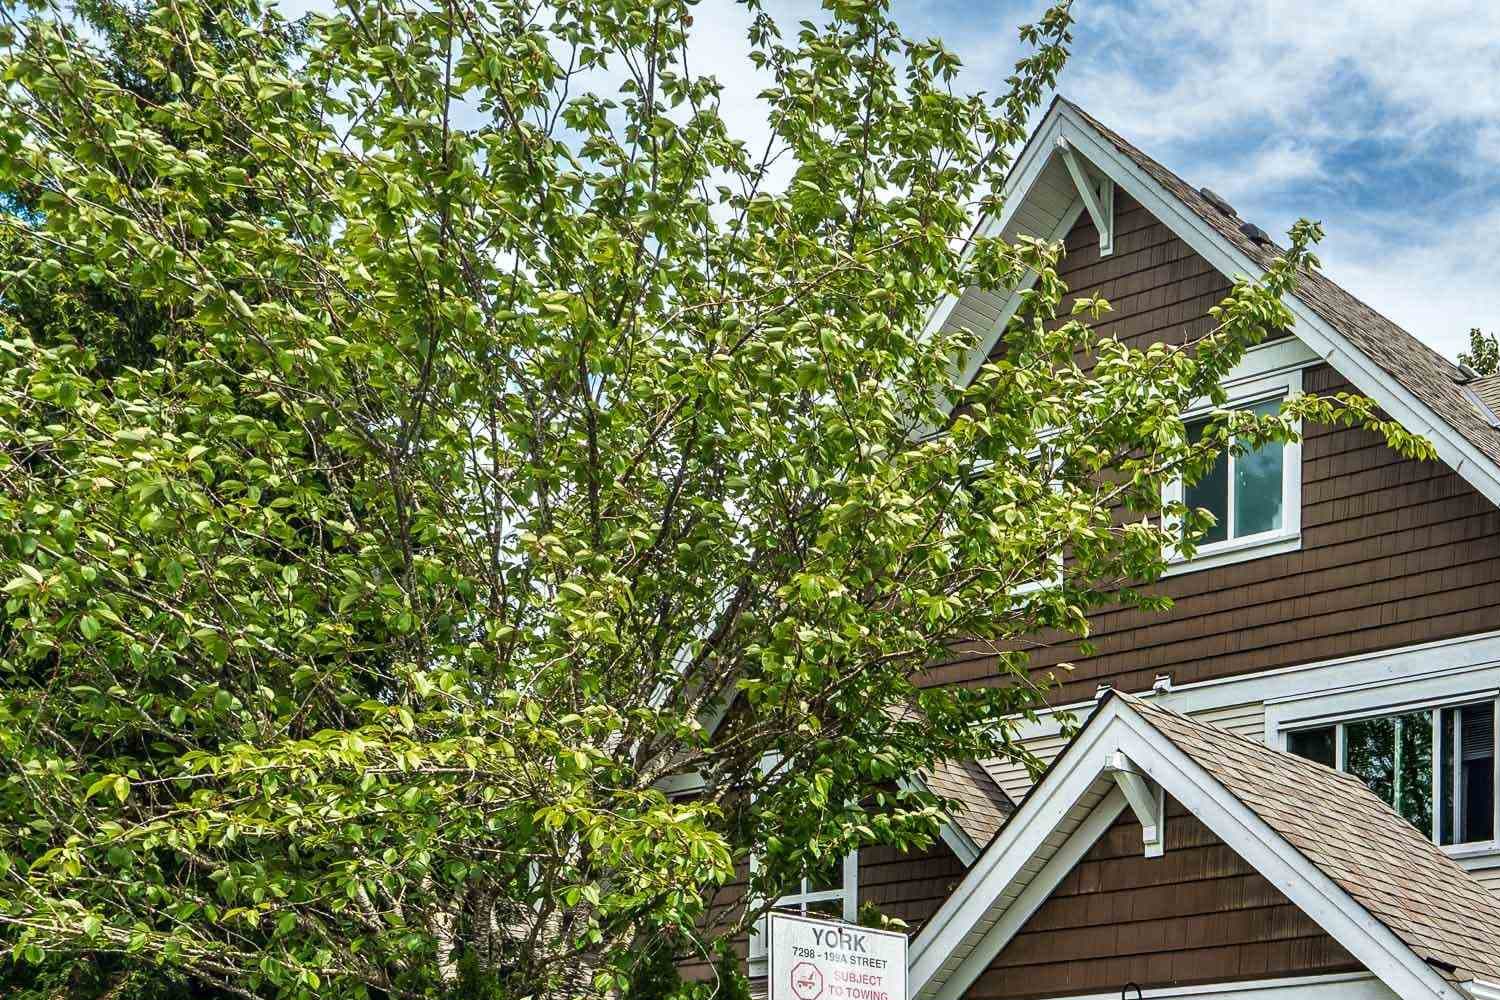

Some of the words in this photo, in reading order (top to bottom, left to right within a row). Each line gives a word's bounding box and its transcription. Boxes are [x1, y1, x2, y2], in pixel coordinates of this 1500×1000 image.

[812, 928, 866, 953] YORK
[792, 946, 815, 959] 7298
[850, 955, 887, 969] STREET
[833, 970, 883, 986] SUBJECT
[829, 984, 844, 996] TO
